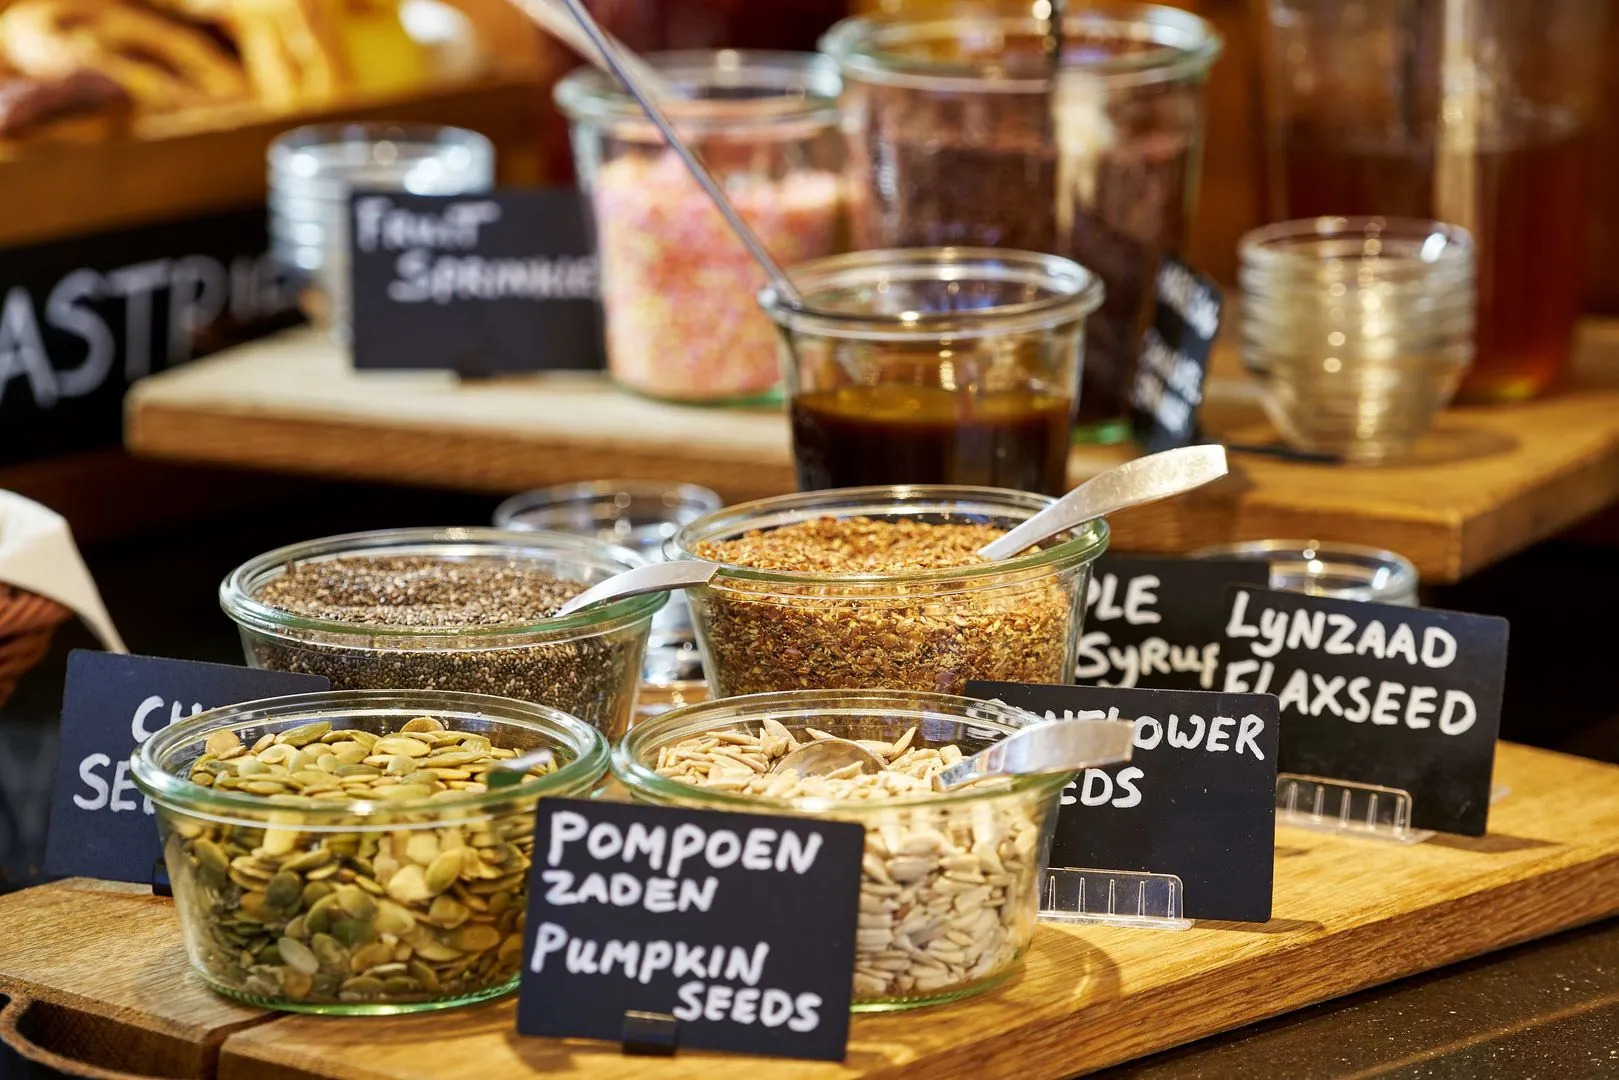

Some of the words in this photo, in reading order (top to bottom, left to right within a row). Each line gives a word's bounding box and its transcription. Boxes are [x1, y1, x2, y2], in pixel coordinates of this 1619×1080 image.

[355, 196, 502, 252] FRUIT
[1223, 659, 1478, 736] FLAXSEED
[548, 811, 824, 878] POMPOEN
[542, 870, 719, 913] ZADEN
[673, 981, 823, 1033] SEEDS
